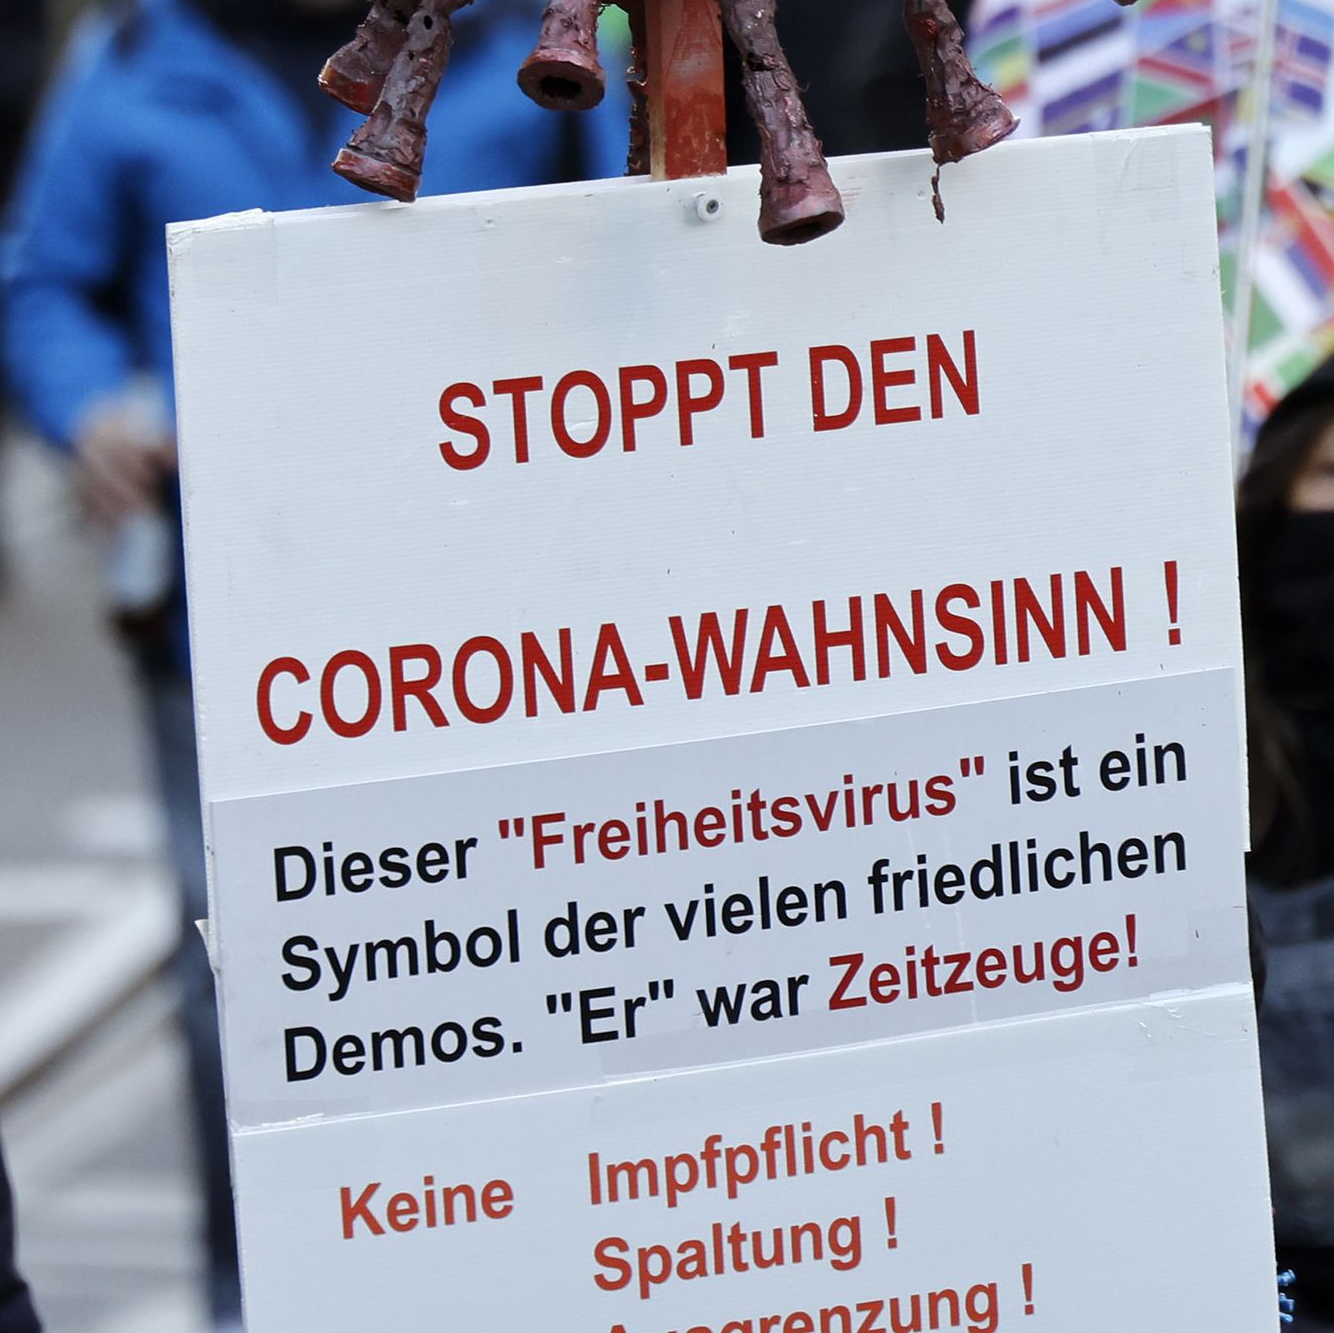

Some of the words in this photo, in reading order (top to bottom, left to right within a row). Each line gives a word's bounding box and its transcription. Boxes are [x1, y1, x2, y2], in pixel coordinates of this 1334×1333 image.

[439, 352, 778, 471] STOPPT
[809, 331, 979, 432] DEN
[257, 567, 1126, 745] CORONA-WAHNSINN
[1164, 561, 1182, 645] !
[273, 838, 478, 902] Dieser
[498, 756, 984, 869] "Freiheitsvirus"
[1008, 746, 1081, 805] ist
[1099, 733, 1187, 793] ein
[281, 909, 520, 1002] Symbol
[544, 902, 646, 958] der
[663, 876, 847, 941] vielen
[867, 831, 1186, 915] friedlichen
[284, 1017, 522, 1083] Demos.
[546, 979, 674, 1044] "Er"
[695, 975, 810, 1028] war
[829, 915, 1138, 1011] Zeitzeuge!
[341, 1180, 513, 1239] Keine
[589, 1113, 911, 1208] Impfpflicht
[932, 1103, 946, 1155] !
[594, 1217, 861, 1299] Spaltung
[885, 1198, 900, 1250] !
[1022, 1264, 1035, 1314] !
